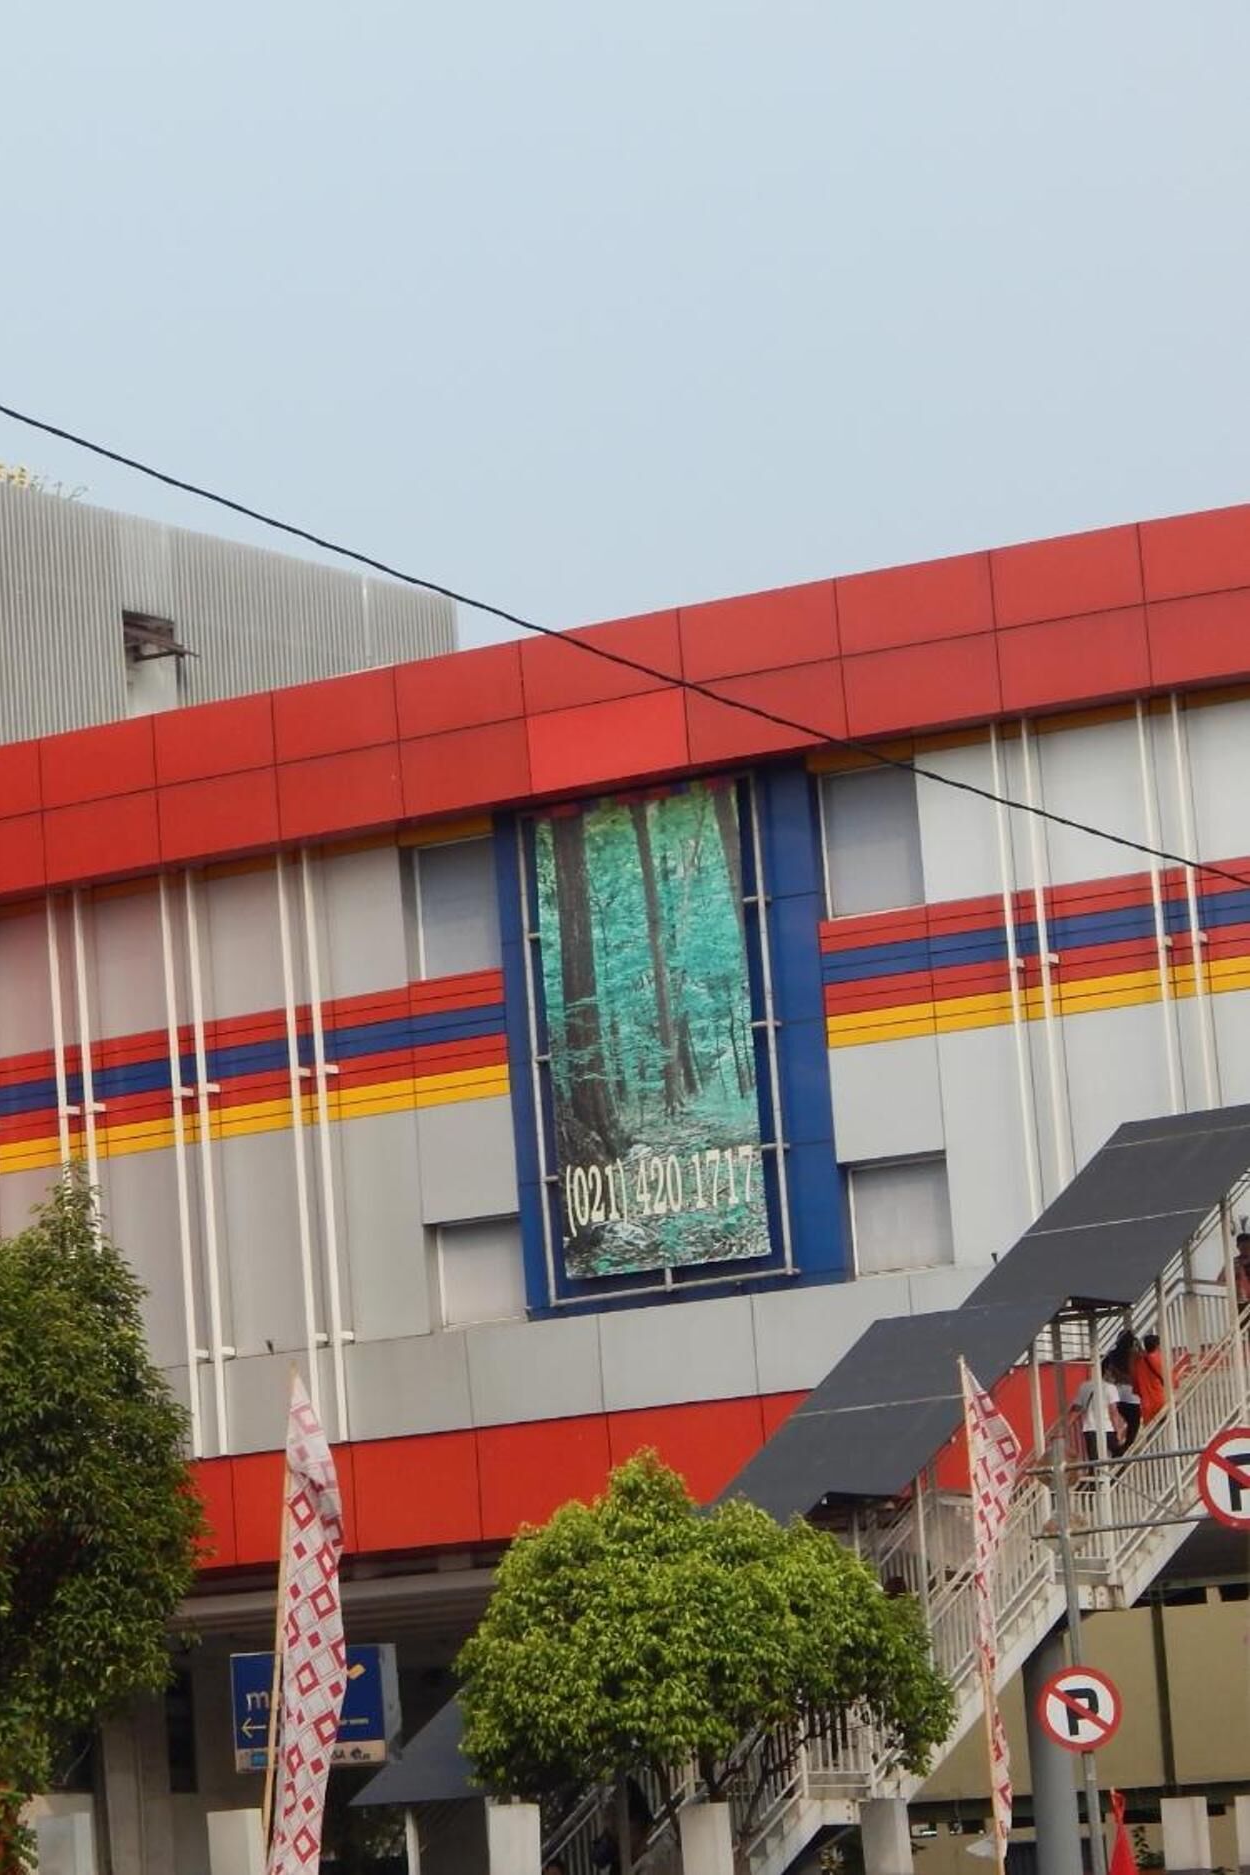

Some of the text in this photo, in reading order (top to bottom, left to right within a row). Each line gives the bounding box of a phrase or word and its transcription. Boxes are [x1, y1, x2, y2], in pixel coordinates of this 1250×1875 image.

[566, 1144, 757, 1237] (021) 420 1717
